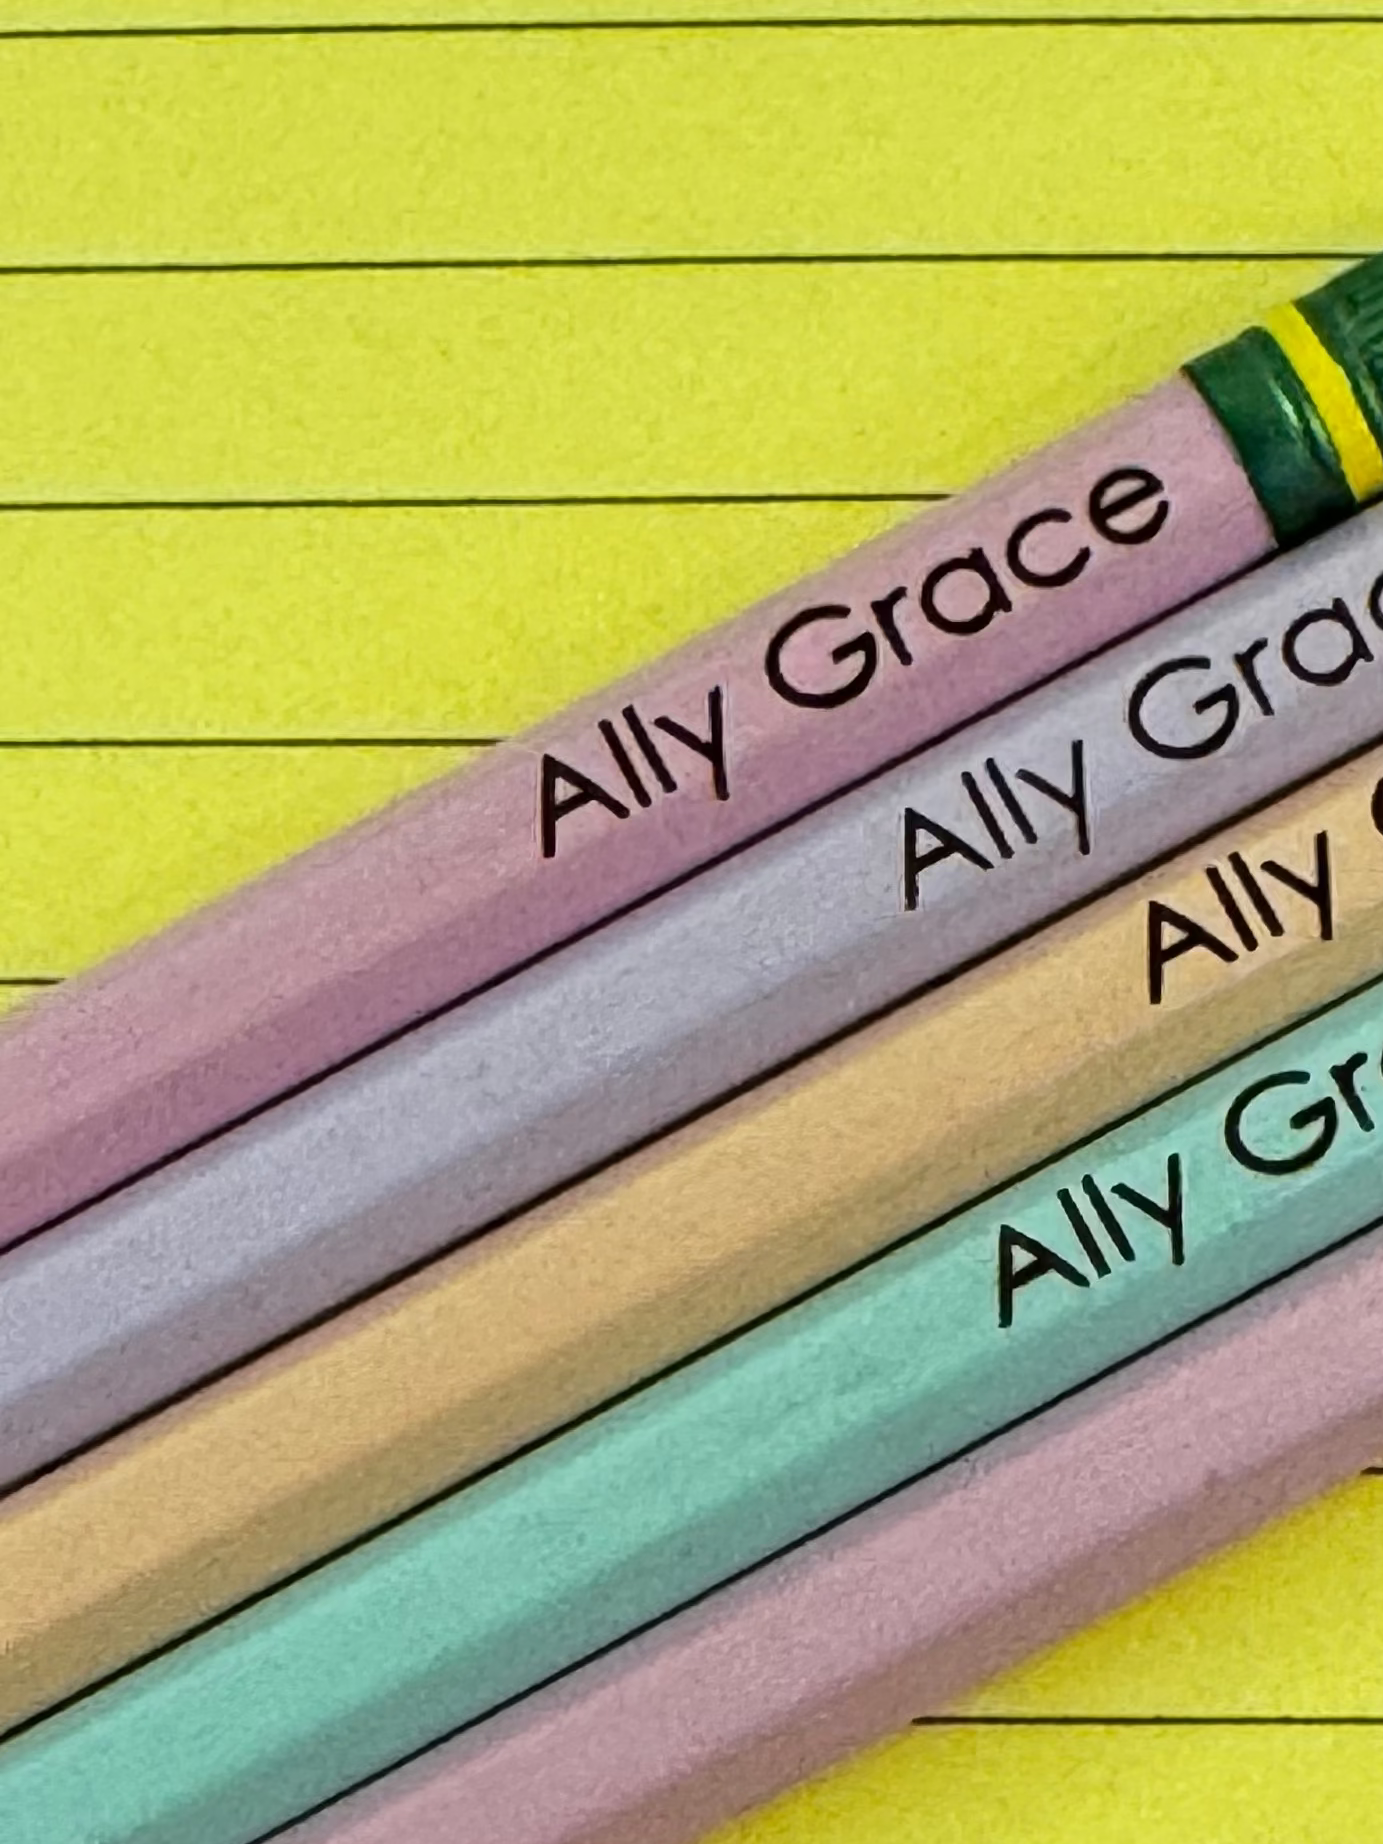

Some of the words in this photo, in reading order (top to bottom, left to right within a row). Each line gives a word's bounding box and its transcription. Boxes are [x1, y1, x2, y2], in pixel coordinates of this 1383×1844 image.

[540, 684, 731, 860] Ally
[764, 466, 1170, 710] Grace
[903, 738, 1092, 912] Ally
[1147, 829, 1334, 1006] Ally
[997, 1152, 1186, 1330] Ally
